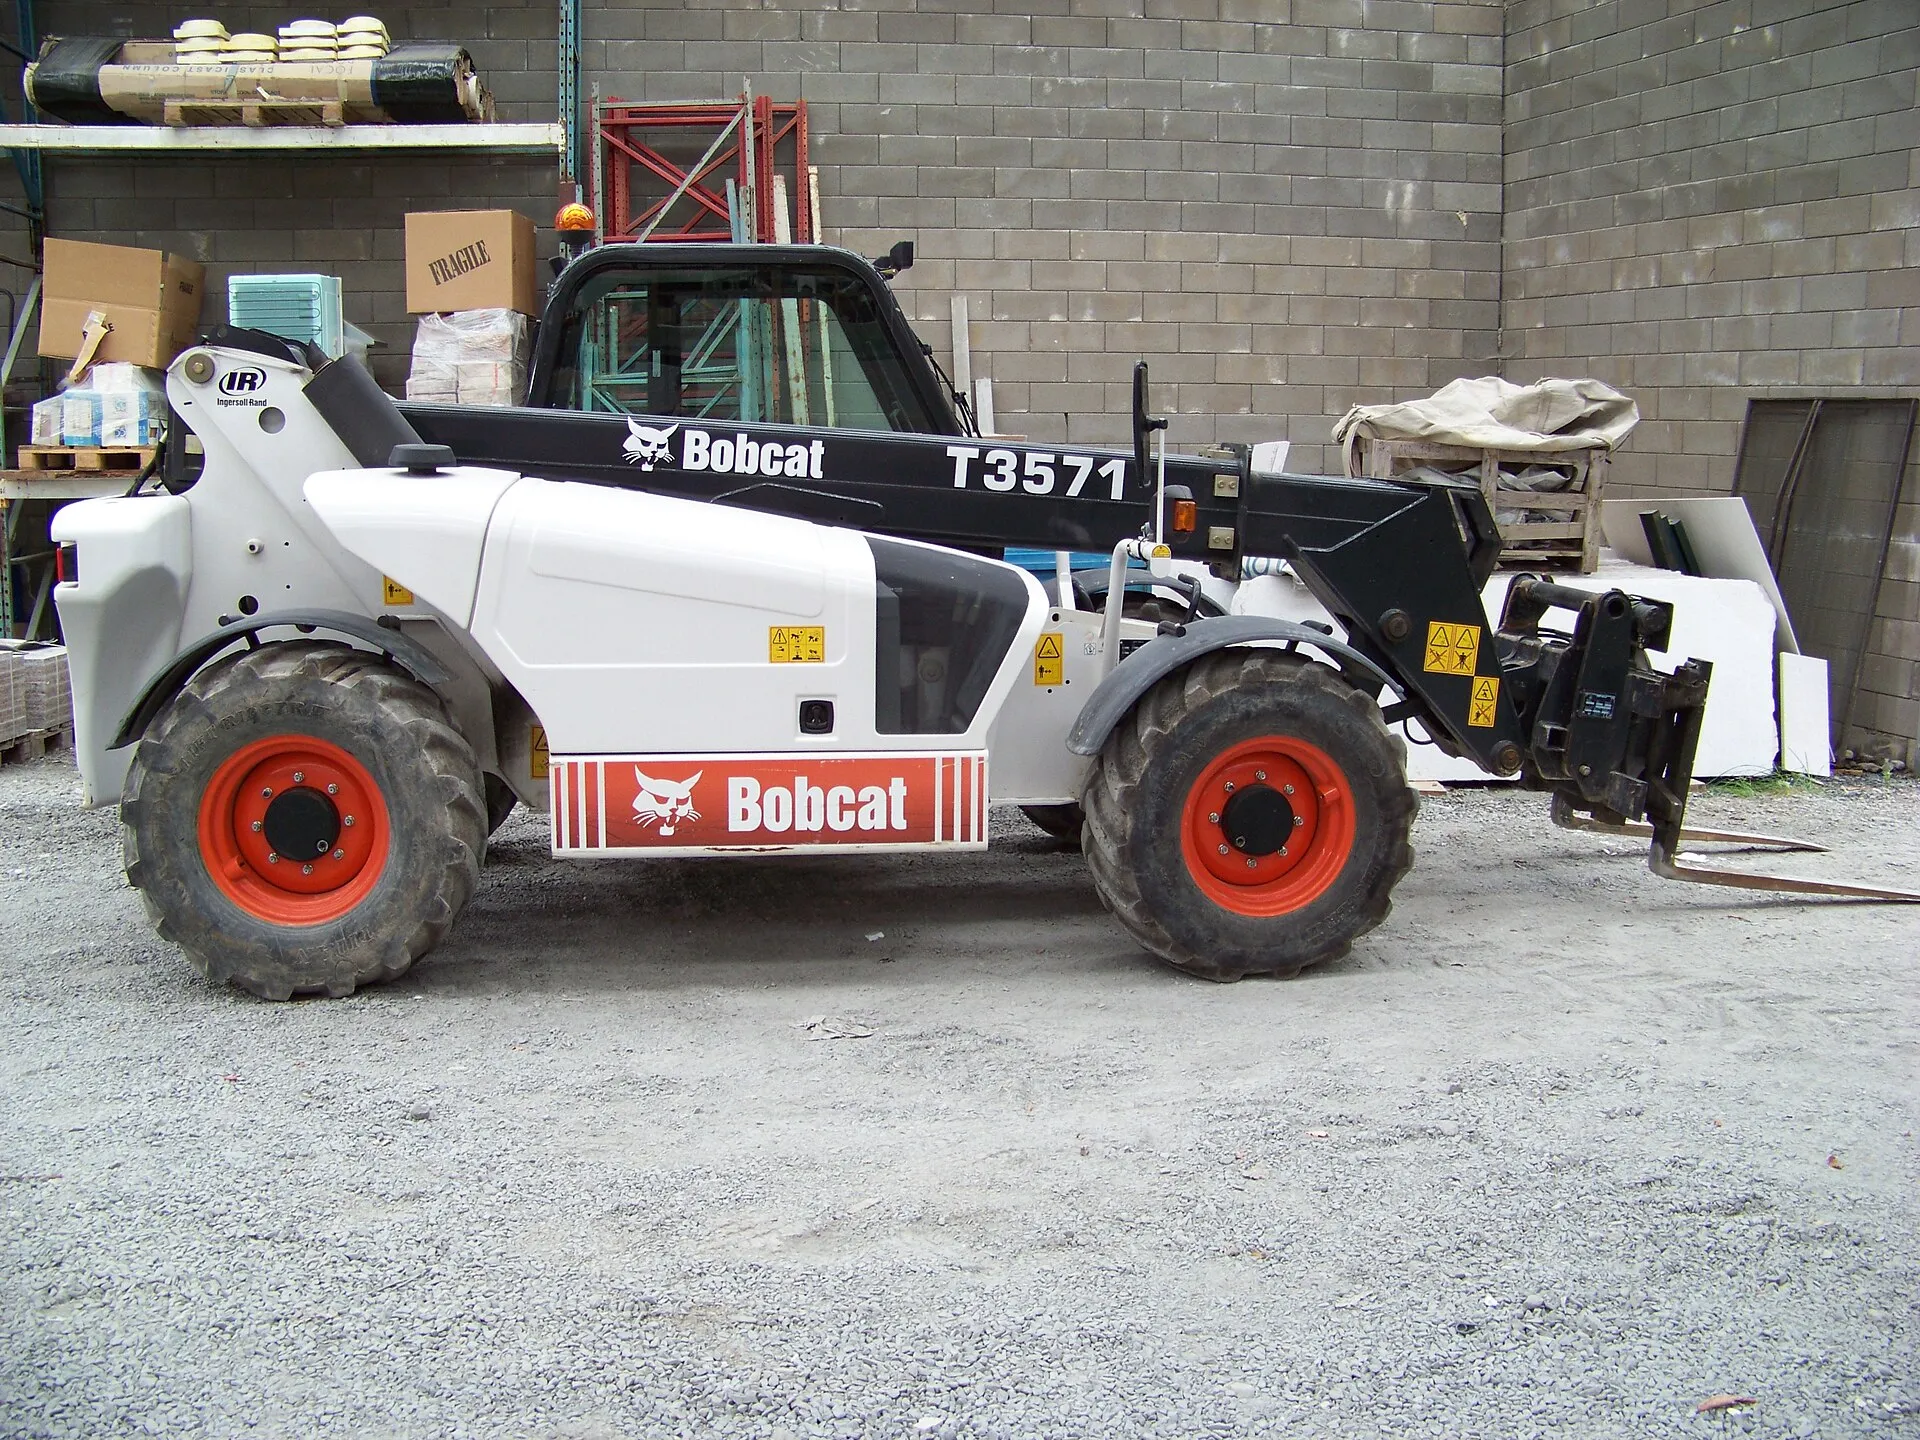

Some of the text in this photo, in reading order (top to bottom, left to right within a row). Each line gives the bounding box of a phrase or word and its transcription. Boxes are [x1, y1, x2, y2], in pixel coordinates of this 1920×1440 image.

[429, 239, 491, 286] FRAGILE
[226, 372, 259, 391] IR
[682, 429, 825, 479] Bobcat
[946, 446, 1126, 501] T3571
[728, 776, 907, 832] Bobcat
